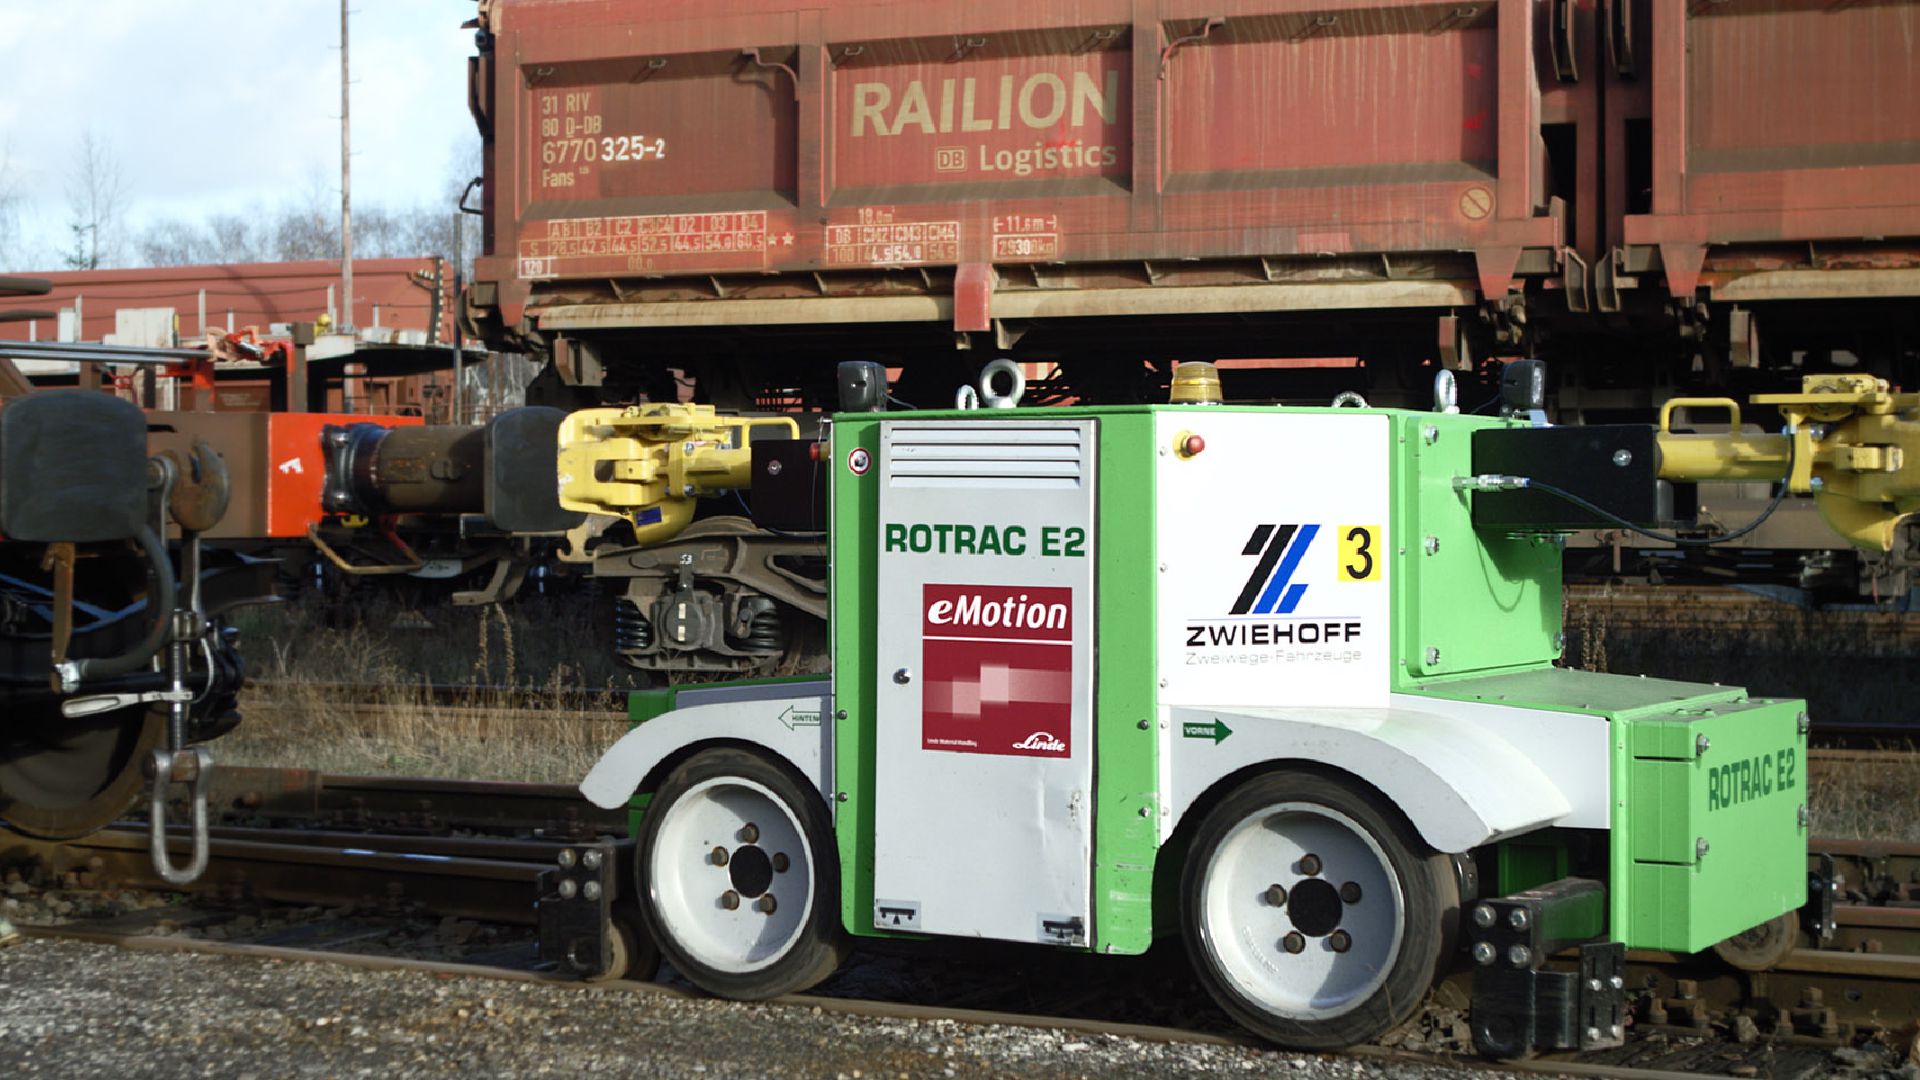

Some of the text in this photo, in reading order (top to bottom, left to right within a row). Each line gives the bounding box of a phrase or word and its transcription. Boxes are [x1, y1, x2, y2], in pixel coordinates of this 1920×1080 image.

[542, 92, 591, 114] 31 RIV
[852, 69, 1119, 137] RAILION
[542, 117, 559, 137] 80
[542, 135, 665, 164] 6770 325-2
[938, 140, 1117, 176] DB Logistics
[542, 169, 575, 188] Fans
[615, 219, 633, 236] C2
[679, 216, 696, 233] D2
[711, 215, 727, 231] D3
[835, 228, 851, 244] DB
[524, 260, 543, 275] 120
[885, 523, 1086, 557] ROTRAC E2
[1345, 526, 1373, 580] 3
[927, 594, 1068, 630] eMotion
[1186, 622, 1361, 647] ZWIEHOFF
[1012, 730, 1066, 752] Linde
[1184, 726, 1216, 737] VORNE
[1708, 747, 1795, 812] ROTRAC E2
